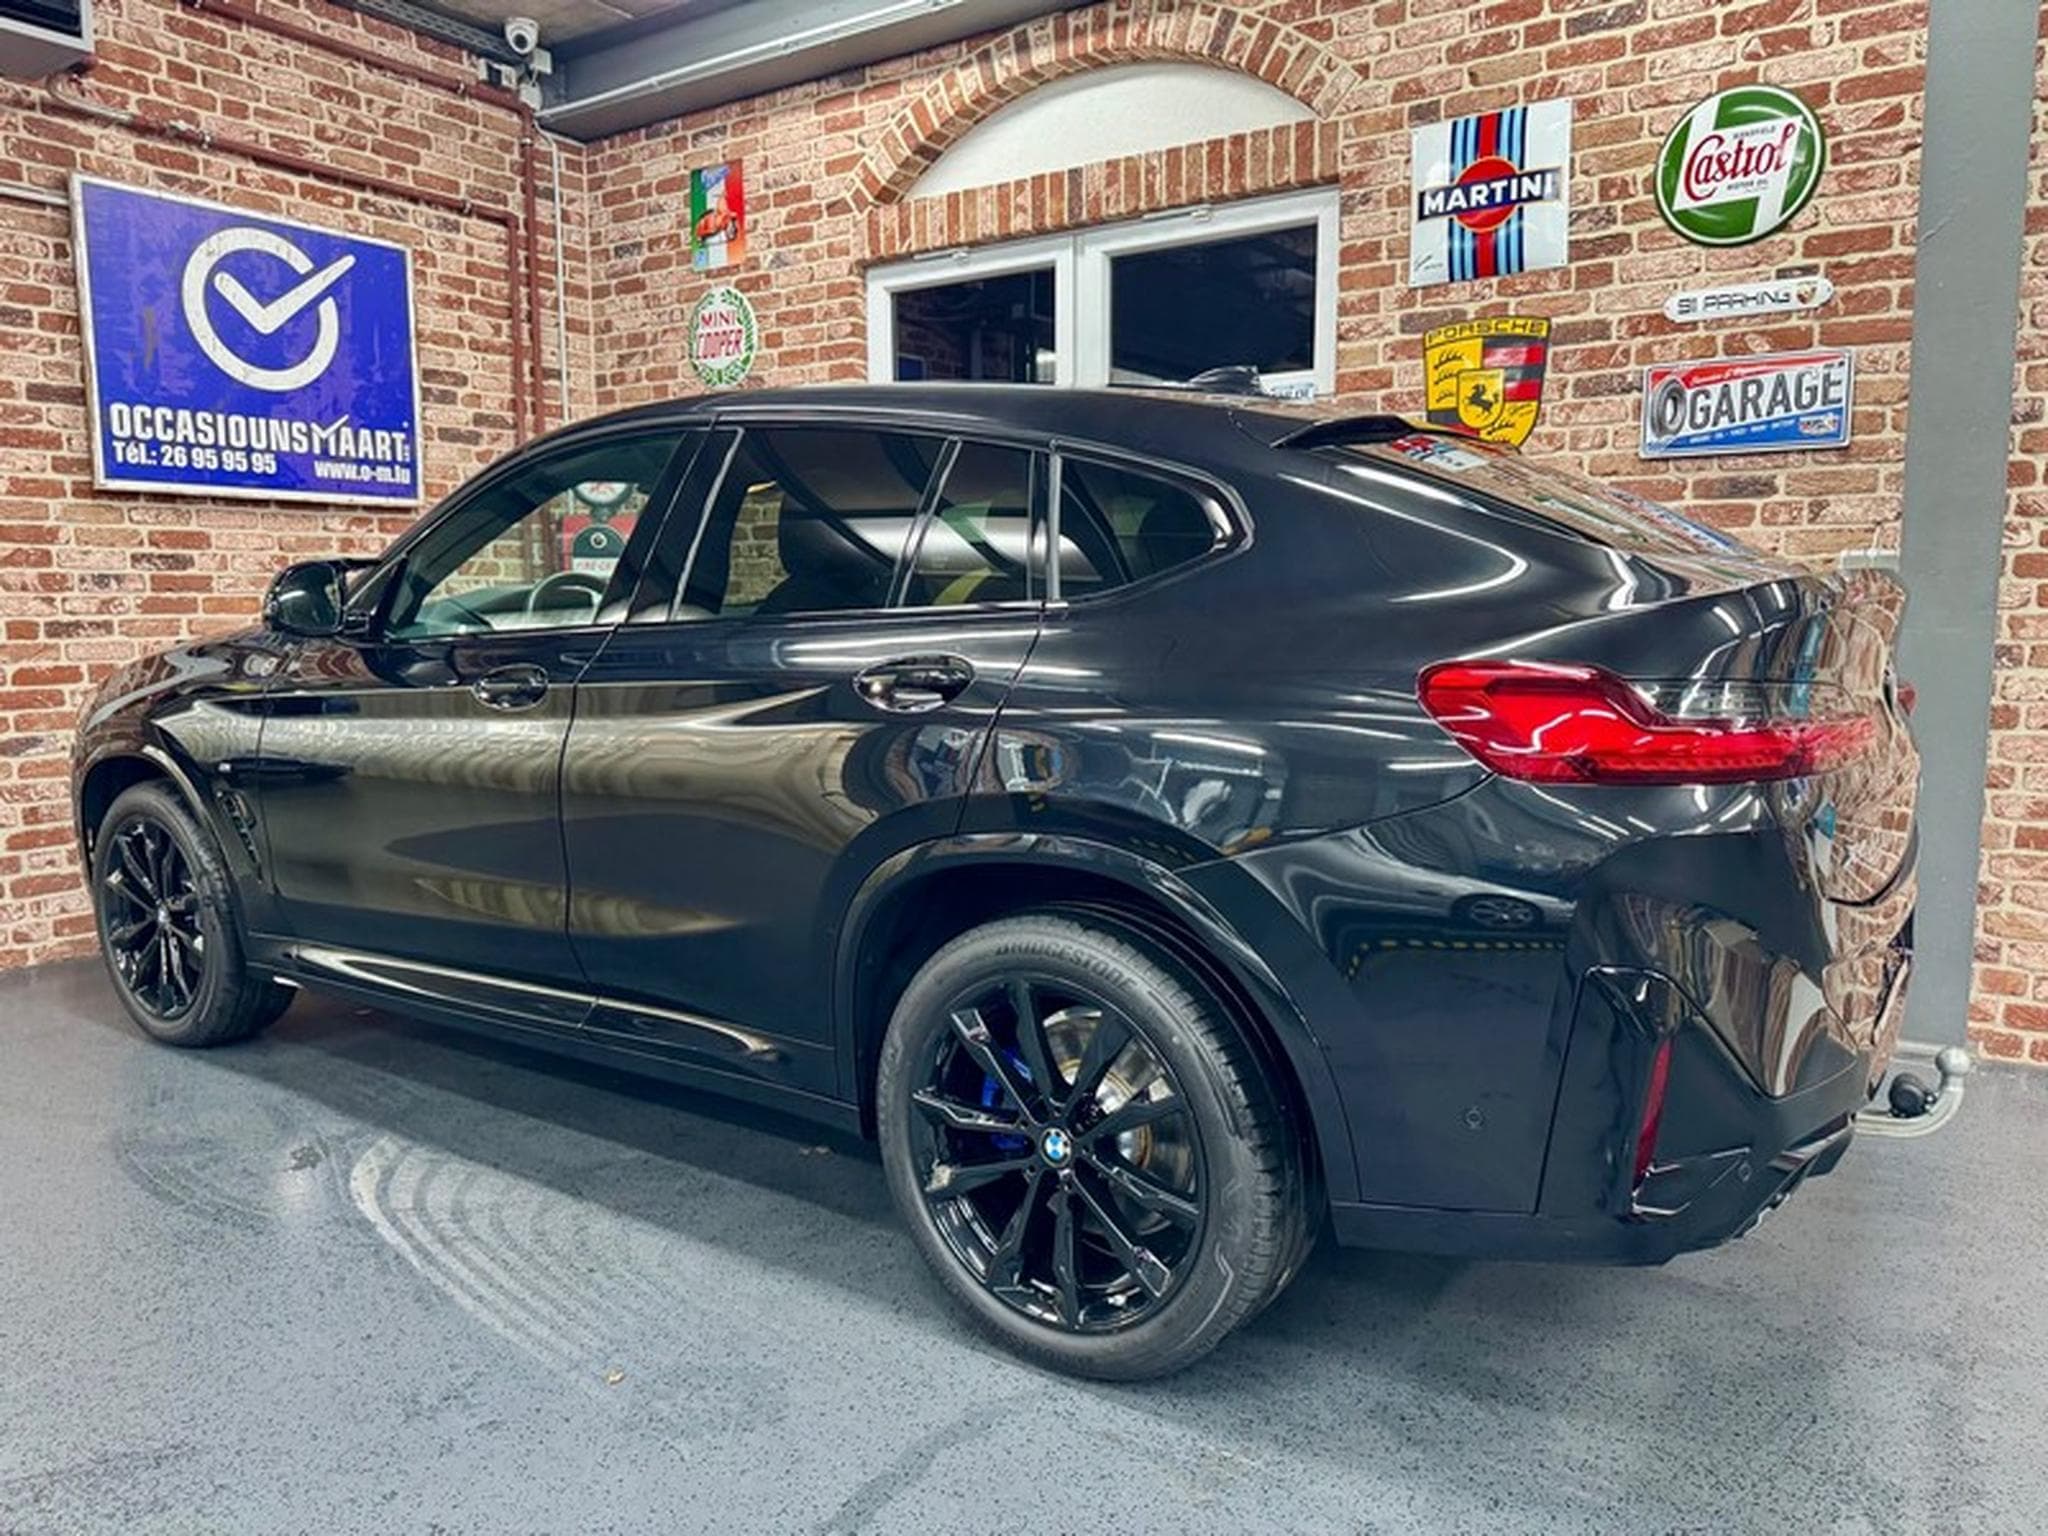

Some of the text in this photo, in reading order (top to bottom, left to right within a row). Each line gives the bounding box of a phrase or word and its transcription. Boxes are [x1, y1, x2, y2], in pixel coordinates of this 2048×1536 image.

[1683, 122, 1796, 202] Castrol
[1423, 173, 1553, 216] MARTINI
[701, 310, 736, 327] MINI
[1427, 320, 1543, 343] PORSCHE
[696, 329, 743, 360] COOPER
[1688, 359, 1845, 430] GARAGE
[161, 444, 188, 468] 26
[191, 447, 219, 471] 95
[222, 450, 249, 473] 95
[251, 452, 278, 475] 95
